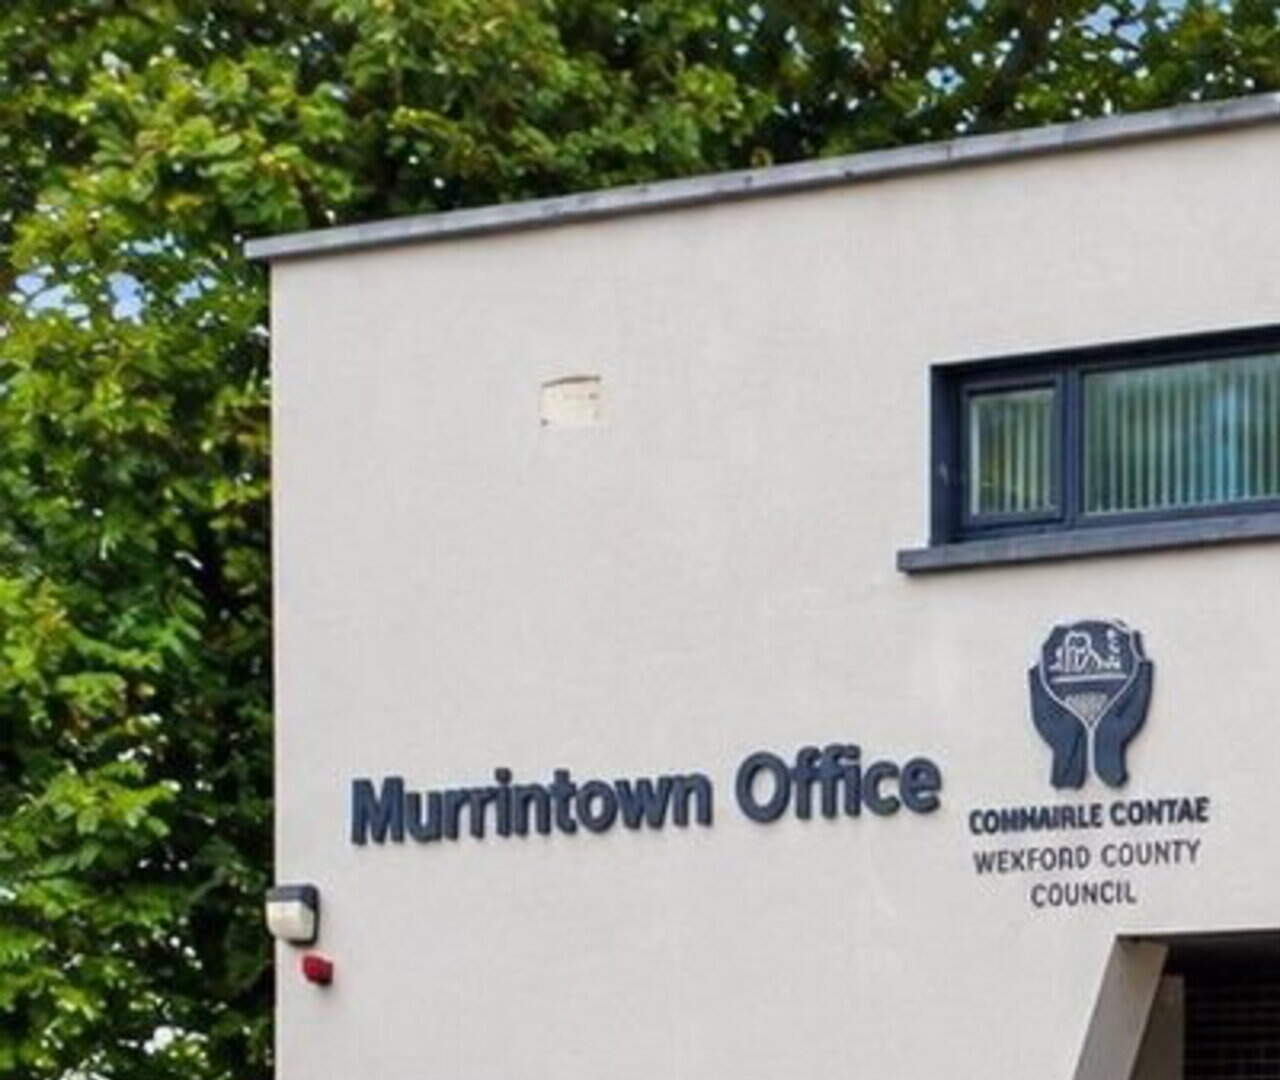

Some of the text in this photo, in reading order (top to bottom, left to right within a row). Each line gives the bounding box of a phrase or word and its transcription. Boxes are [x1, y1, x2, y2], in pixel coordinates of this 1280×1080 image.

[350, 744, 943, 845] Murrintown Office
[1110, 796, 1210, 827] CONTAE
[972, 838, 1201, 874] WEXFORD COUNTY
[1030, 880, 1137, 908] COUNCIL
